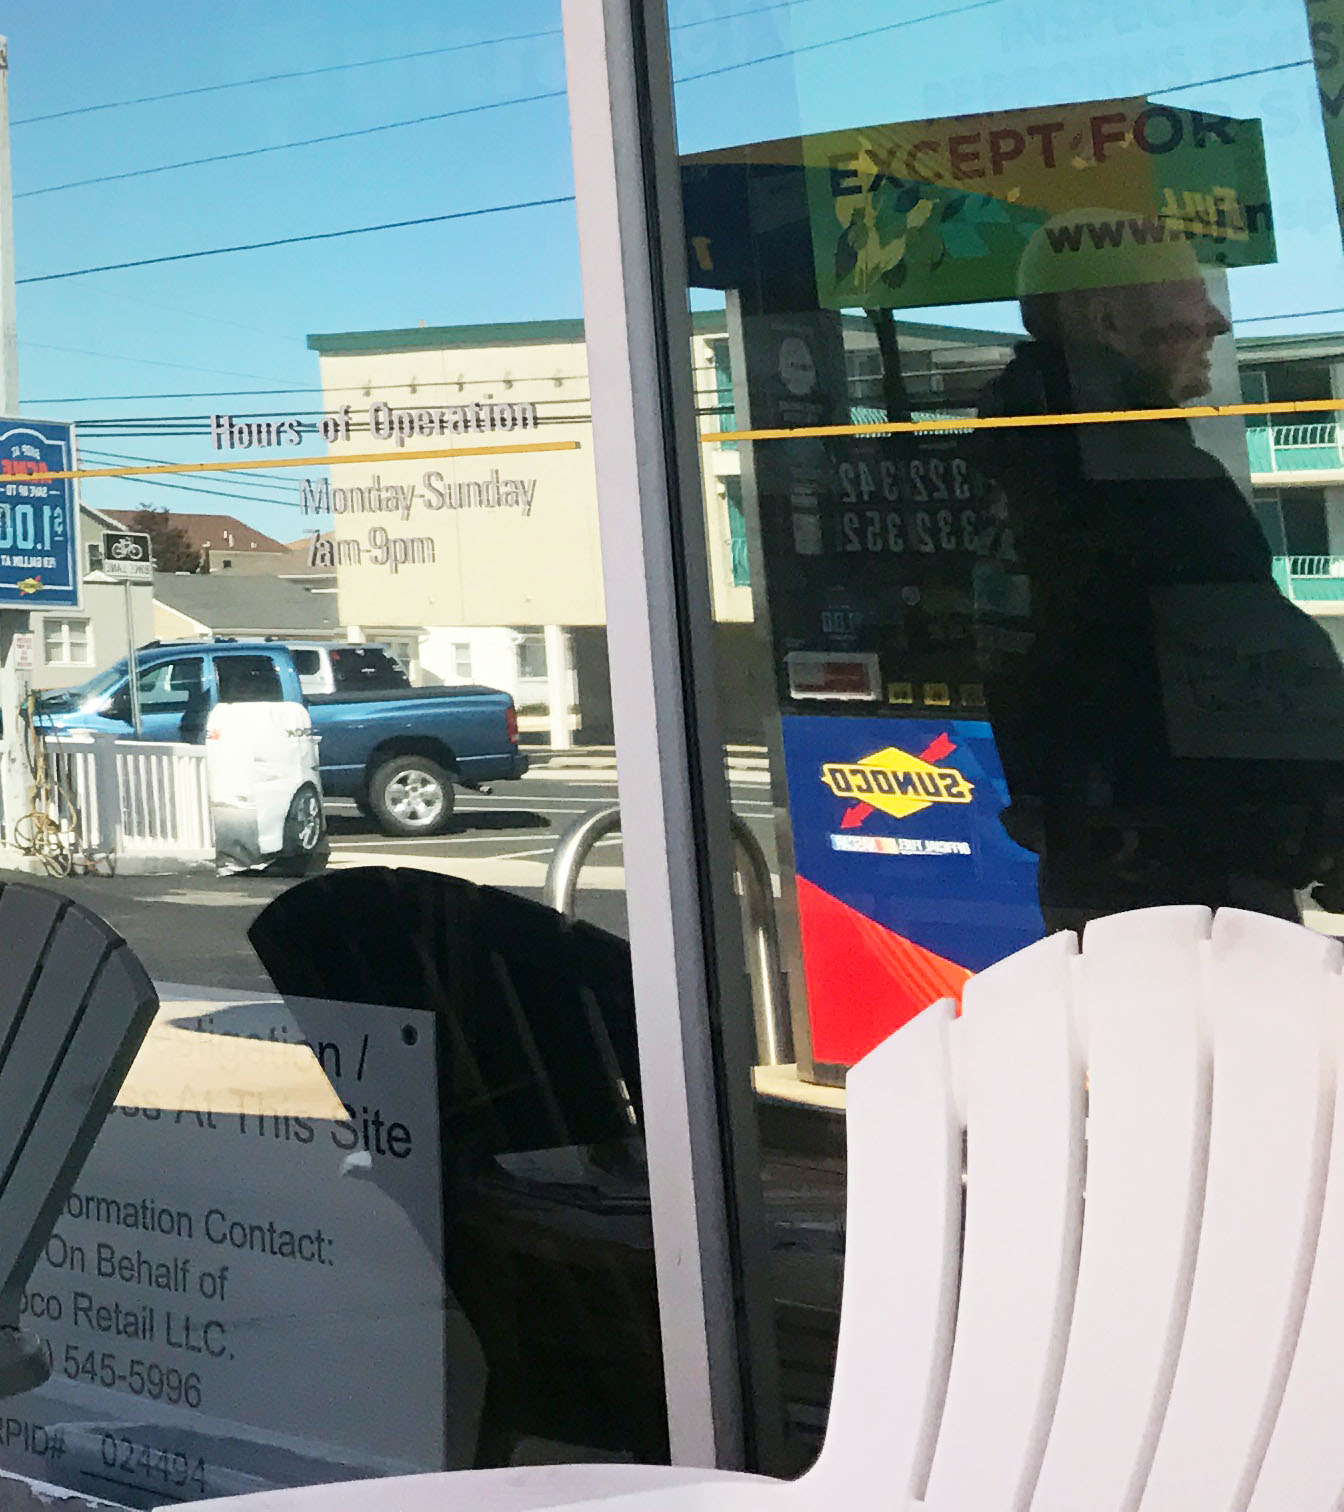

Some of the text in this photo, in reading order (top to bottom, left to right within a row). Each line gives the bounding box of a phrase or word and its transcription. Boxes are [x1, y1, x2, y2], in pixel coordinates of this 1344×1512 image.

[827, 121, 1064, 197] EXCEPT
[1092, 105, 1238, 163] FOR
[210, 399, 539, 450] Hours of Operation
[299, 468, 537, 522] Monday-Sunday
[306, 526, 436, 575] 7am-9pm
[230, 1088, 315, 1144] This
[331, 1105, 412, 1158] Site
[60, 1192, 335, 1267] ormation Contact:
[45, 1234, 230, 1301] On Behalf of
[73, 1292, 155, 1343] Retail
[166, 1317, 236, 1361] LLC.
[64, 1345, 202, 1408] 545-5996
[100, 1431, 208, 1493] 024494
